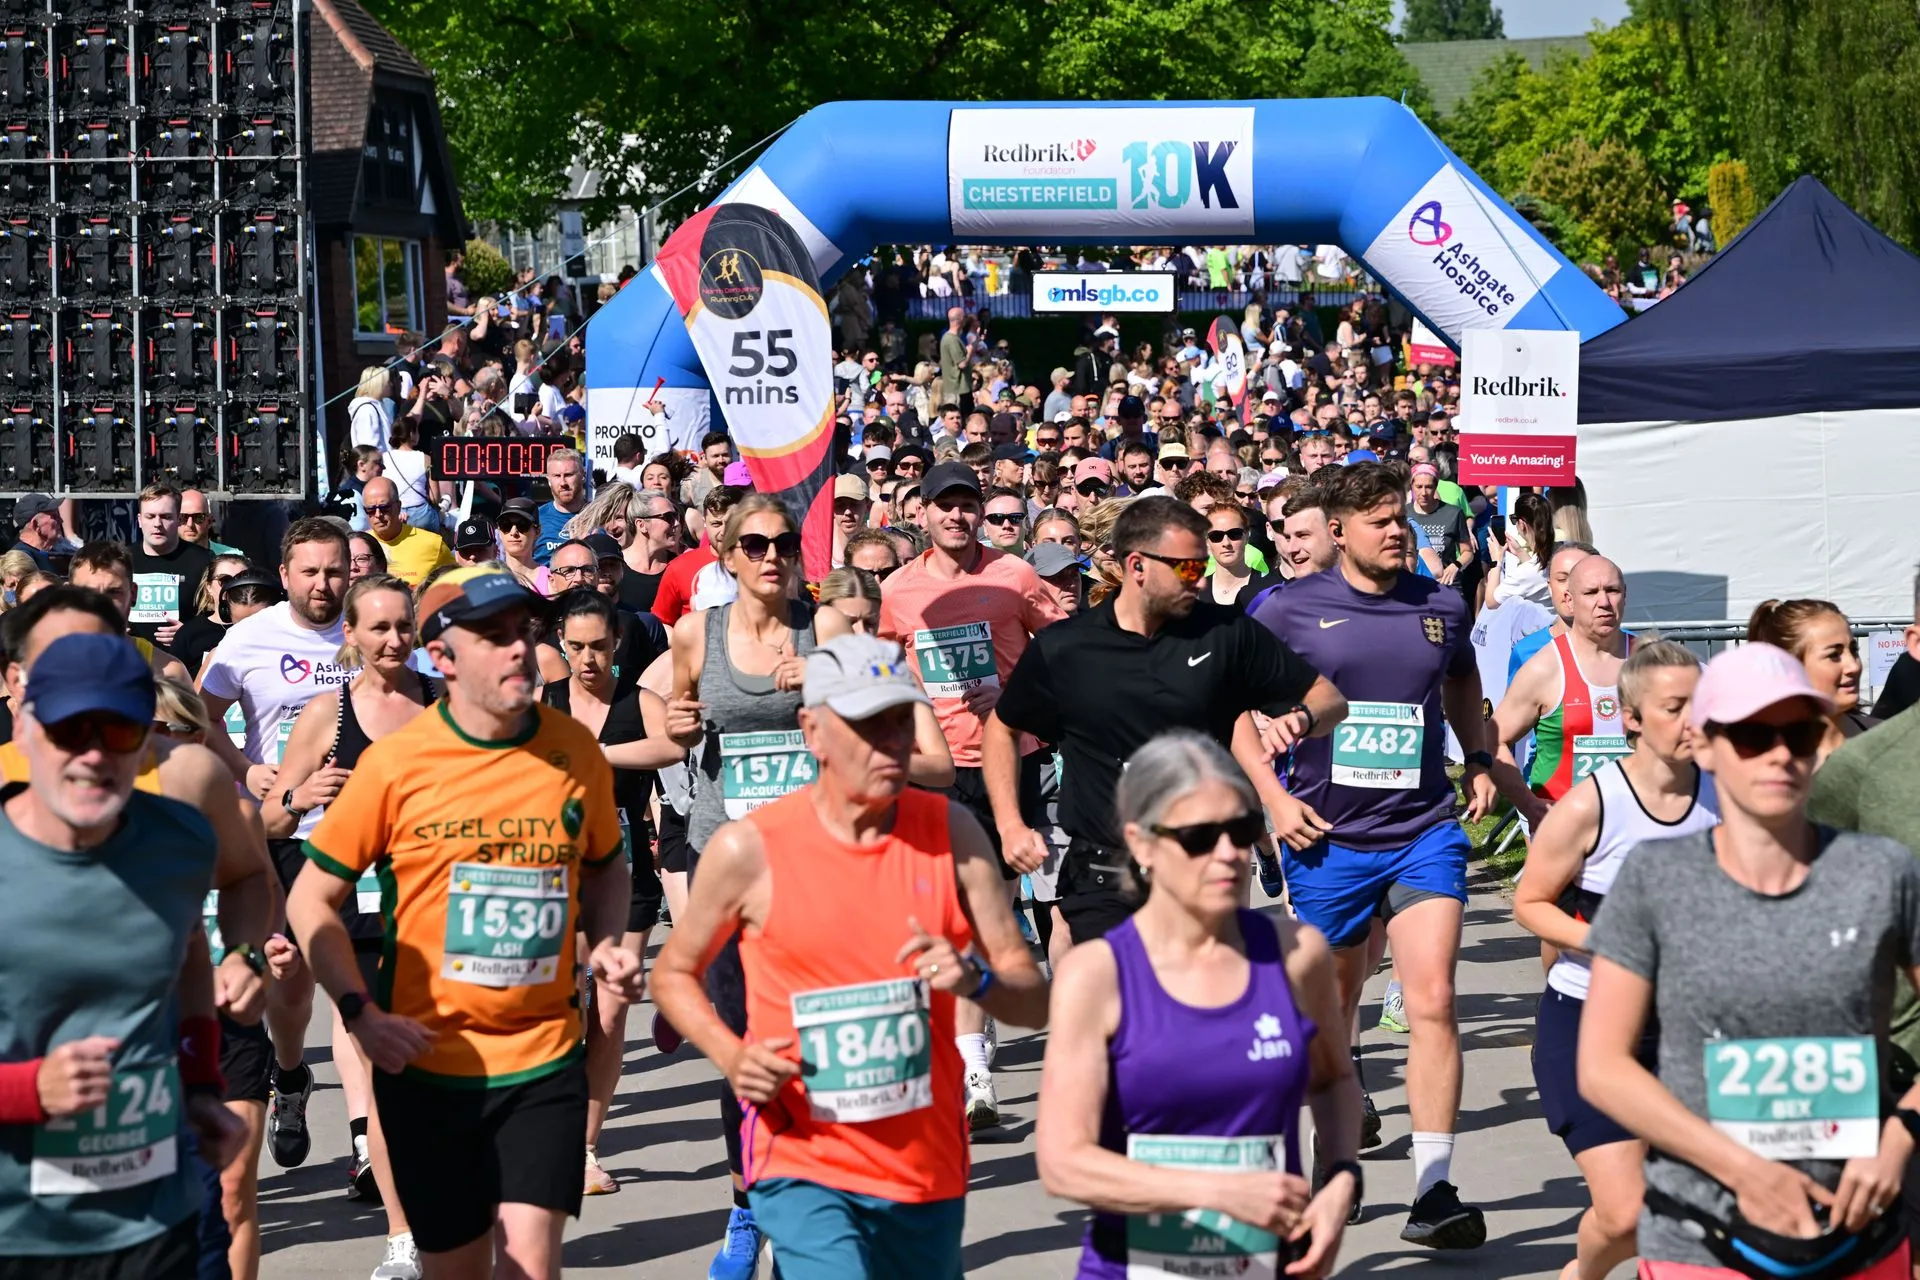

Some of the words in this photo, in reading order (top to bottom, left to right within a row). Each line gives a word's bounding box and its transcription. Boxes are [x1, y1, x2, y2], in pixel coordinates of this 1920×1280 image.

[1023, 166, 1075, 175] Foundation
[1121, 140, 1240, 210] 10K
[968, 186, 1112, 203] CHESTERFIELD
[1446, 241, 1516, 306] Ashgate
[1431, 250, 1500, 317] Hospice
[710, 295, 739, 303] Running
[739, 293, 754, 302] Club
[728, 329, 798, 378] 55
[725, 379, 799, 405] mins
[1494, 416, 1539, 425] redbrik.co.uk
[595, 425, 656, 439] PRONTO
[595, 445, 617, 459] PAI
[1469, 453, 1507, 466] You're
[1508, 454, 1565, 469] Amazing!
[918, 628, 966, 641] CHESTERFIELD
[967, 622, 988, 638] 10K
[1878, 641, 1890, 649] NO
[923, 642, 990, 671] 1575
[314, 673, 354, 686] Hospi
[947, 670, 969, 681] OLLY
[1350, 707, 1396, 716] ESTERFIELD
[1397, 705, 1419, 720] 10K
[724, 734, 785, 747] CHESTERFIELD
[786, 731, 806, 746] 10
[1338, 726, 1418, 755] 2482
[1576, 737, 1625, 747] CHESTERFIELD
[731, 752, 813, 784] 1574
[414, 817, 492, 840] STEEL
[498, 817, 557, 839] CITY
[456, 869, 538, 886] CHESTERFIELD
[458, 898, 563, 939] 1530
[491, 942, 524, 957] ASH
[797, 987, 888, 1012] CHESTERFIELD
[807, 1013, 925, 1071] 1840
[1247, 1038, 1292, 1062] Jan
[844, 1065, 896, 1088] PETER
[1715, 1041, 1867, 1096] 2285
[1771, 1099, 1813, 1120] BEX
[78, 1127, 147, 1152] GEORGE
[1136, 1143, 1239, 1162] CHESTERFIELD
[1189, 1236, 1226, 1253] JAN
